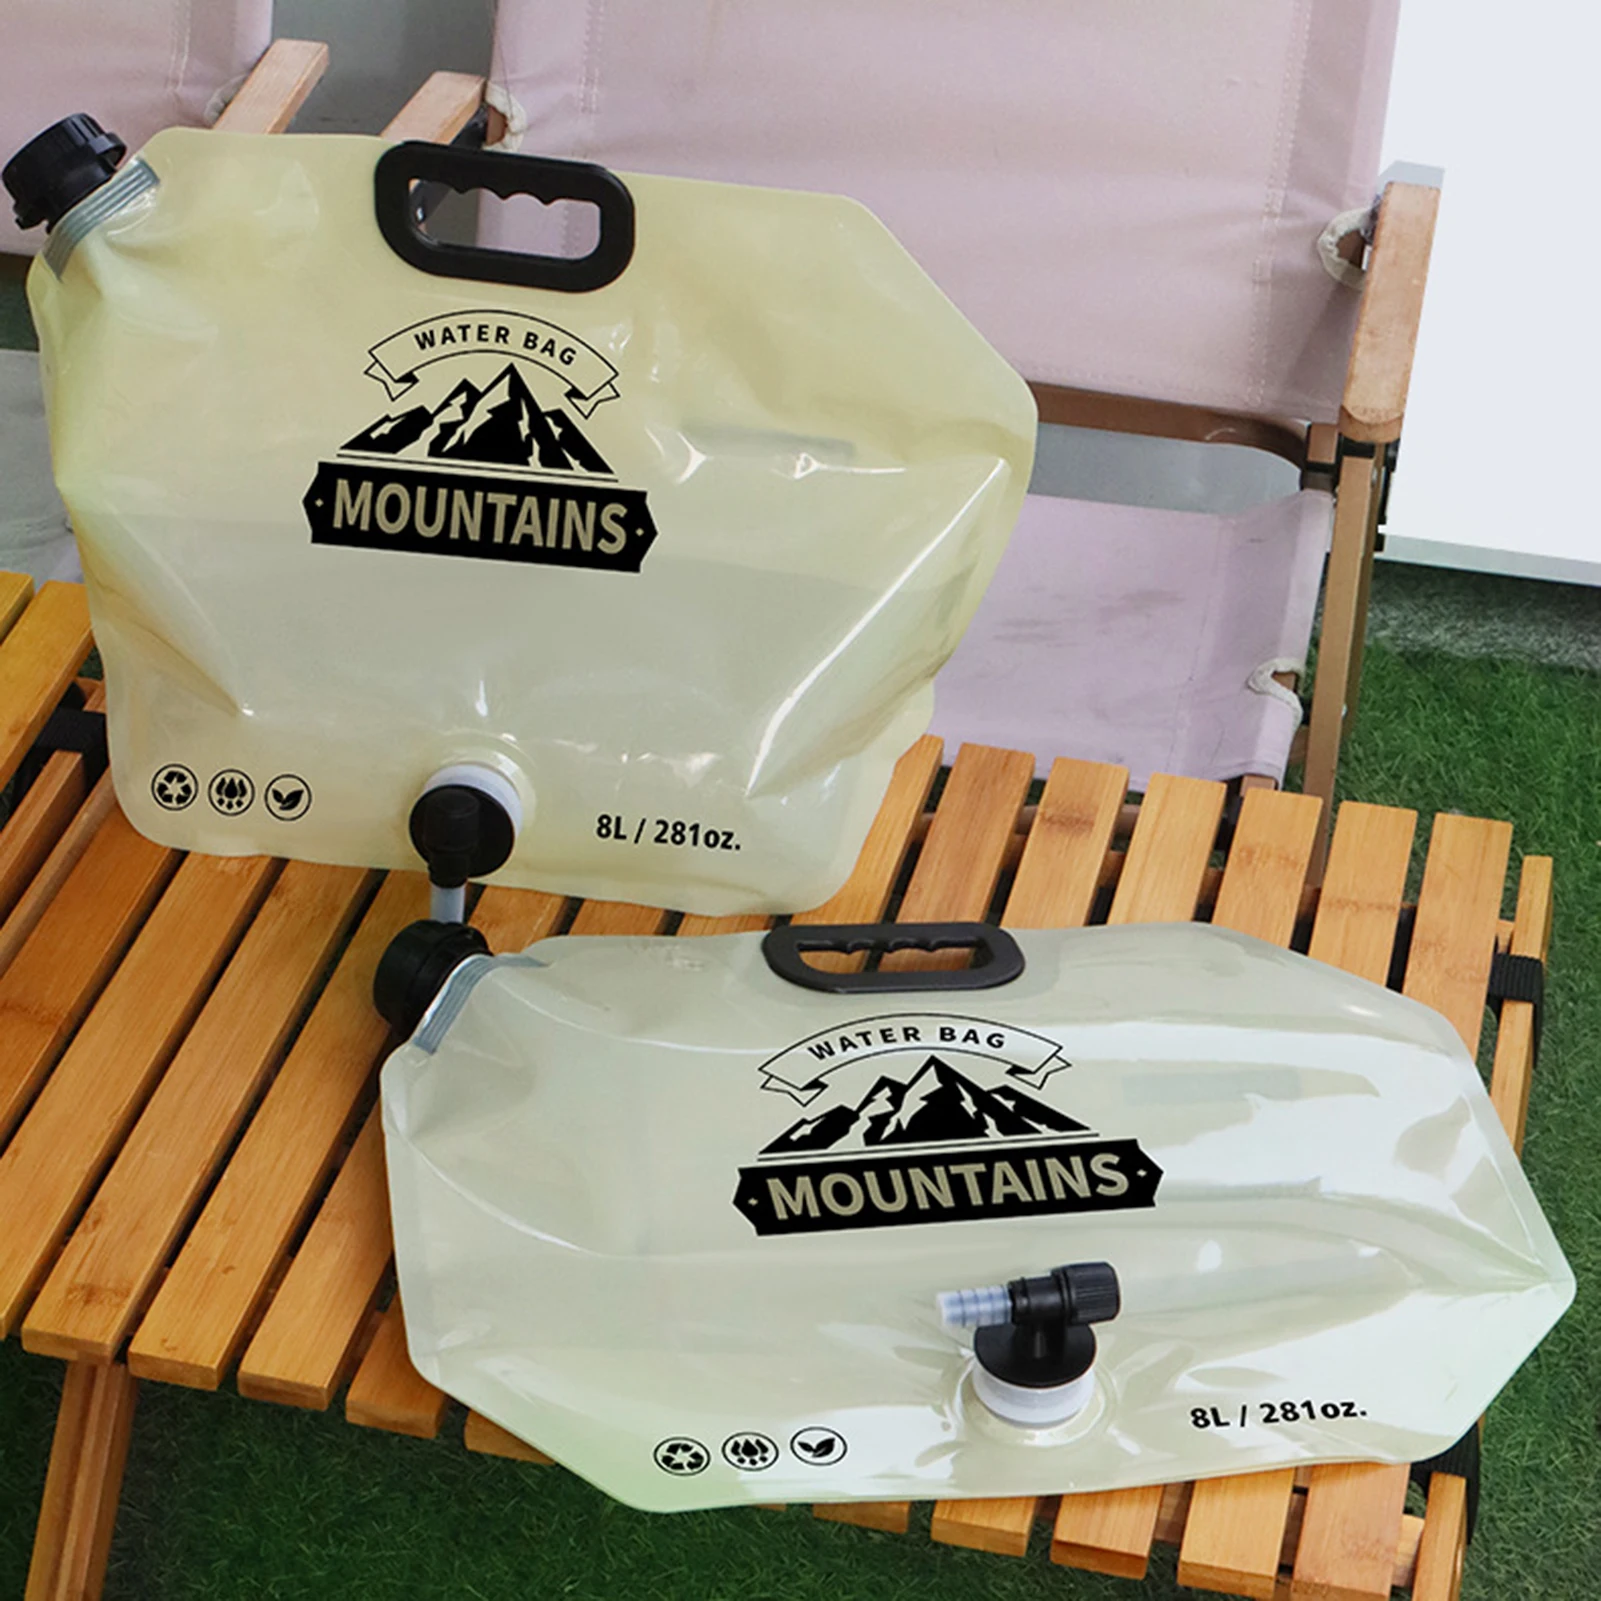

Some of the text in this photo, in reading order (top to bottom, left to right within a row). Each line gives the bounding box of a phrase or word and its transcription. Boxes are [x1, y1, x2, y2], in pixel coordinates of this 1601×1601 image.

[413, 324, 577, 366] WATER BAG
[332, 478, 628, 555] MOUNTAINS
[596, 814, 741, 850] 8L / 281oz.
[807, 1026, 1006, 1061] WATER BAG
[766, 1152, 1130, 1221] MOUNTAINS
[1190, 1400, 1367, 1429] 8L / 281oz.
